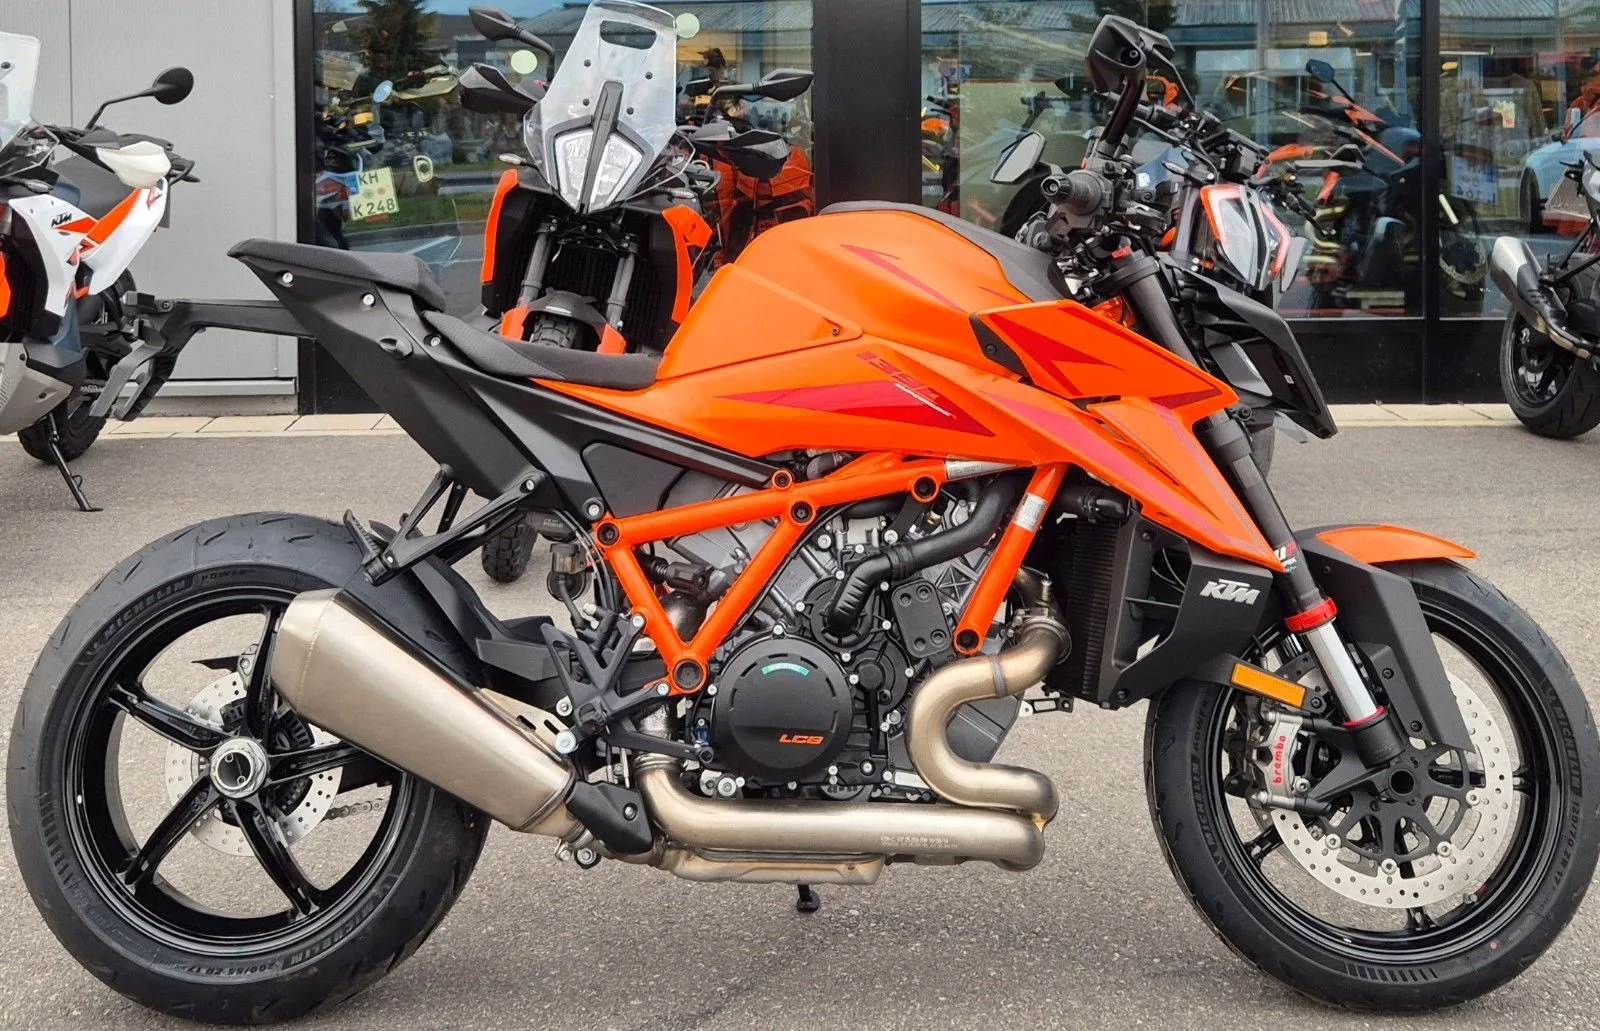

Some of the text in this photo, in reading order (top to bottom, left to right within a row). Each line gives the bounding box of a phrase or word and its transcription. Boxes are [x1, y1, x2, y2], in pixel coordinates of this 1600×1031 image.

[359, 172, 379, 185] KH
[353, 198, 395, 217] K 248
[51, 211, 72, 227] KTM
[1200, 579, 1260, 605] KTM
[103, 579, 186, 640] MICHELIN
[780, 734, 824, 744] LC8
[1553, 705, 1581, 788] MICHELIN
[1273, 735, 1287, 784] brembo
[1192, 763, 1215, 847] MICHELIN
[1567, 801, 1580, 847] 120/70
[1560, 850, 1572, 869] ZR
[290, 900, 374, 965] MICHELIN
[206, 966, 223, 975] ZR
[228, 962, 276, 975] 200/55
